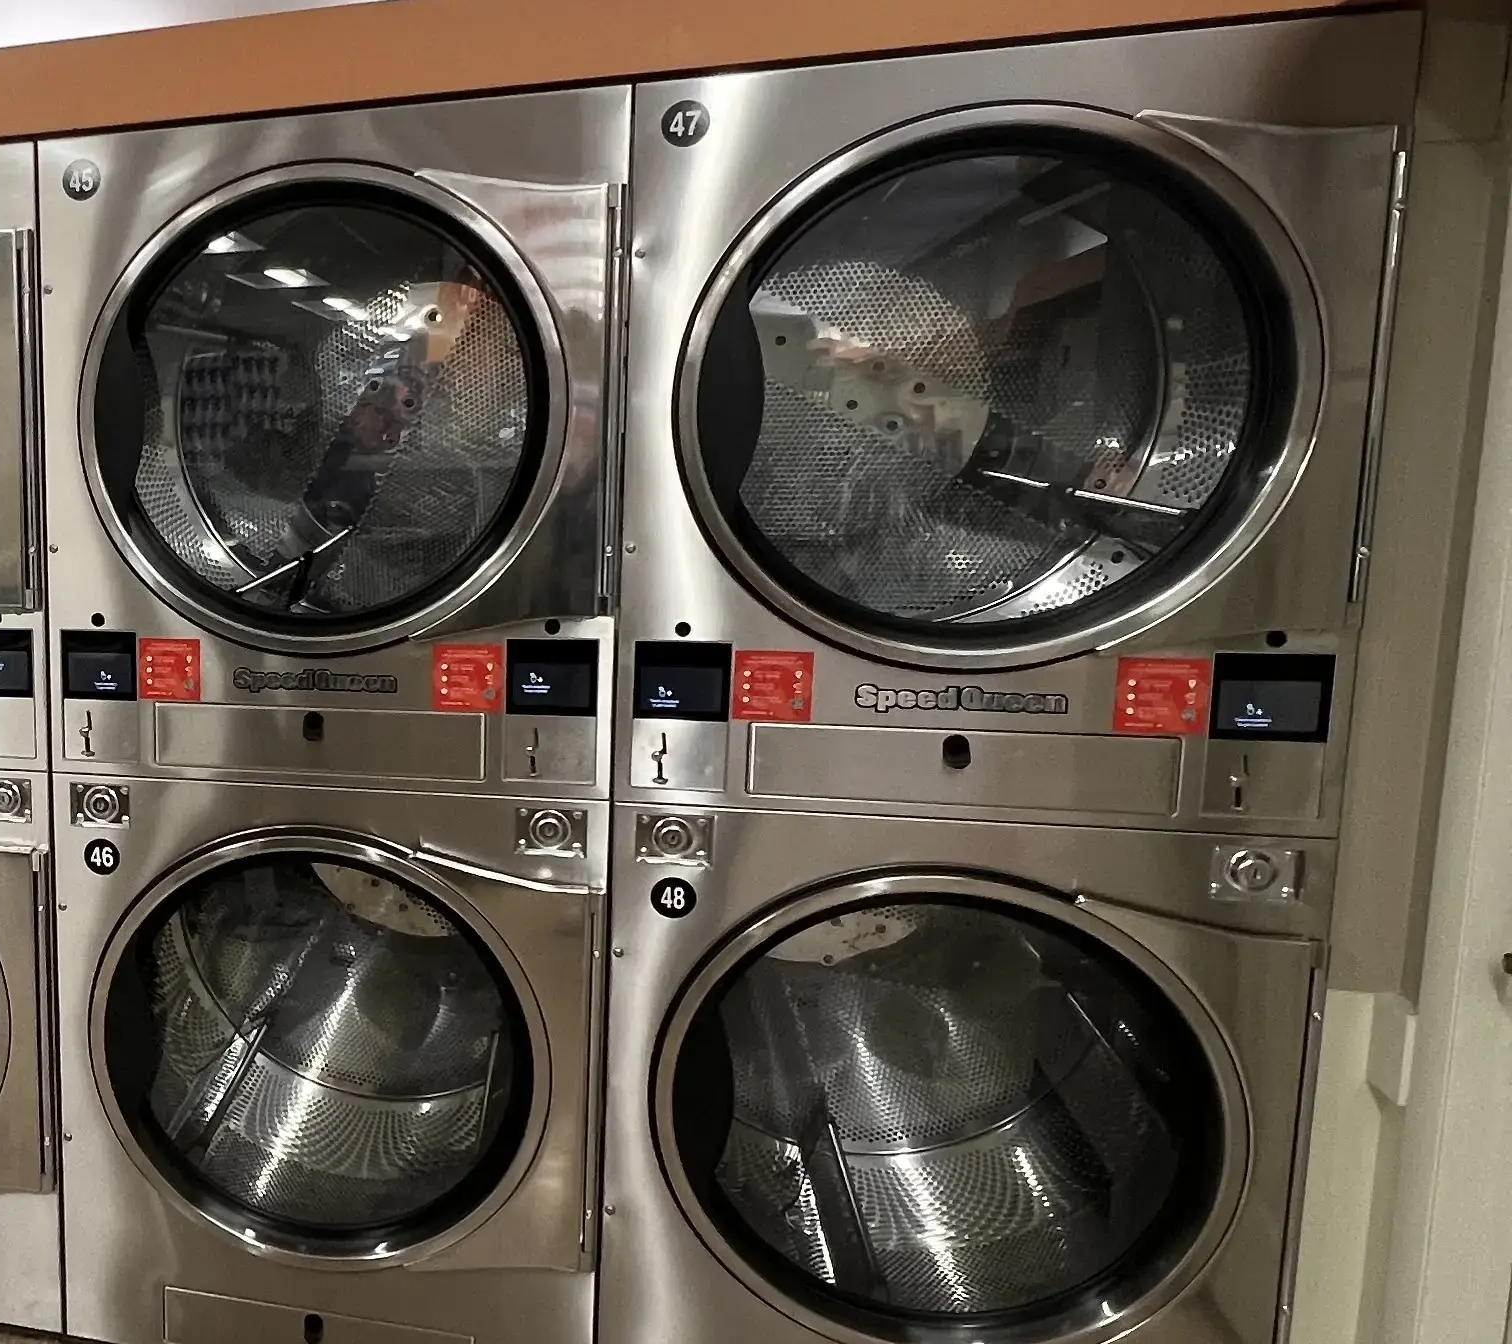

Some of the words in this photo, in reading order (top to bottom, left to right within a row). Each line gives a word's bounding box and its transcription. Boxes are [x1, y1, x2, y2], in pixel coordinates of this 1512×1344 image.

[669, 109, 701, 137] 47
[69, 168, 93, 192] 45
[233, 667, 314, 693] Speed
[315, 669, 398, 693] Queen
[855, 684, 960, 713] Speed
[960, 686, 1068, 714] Queen
[90, 846, 114, 868] 46
[660, 886, 686, 910] 48
